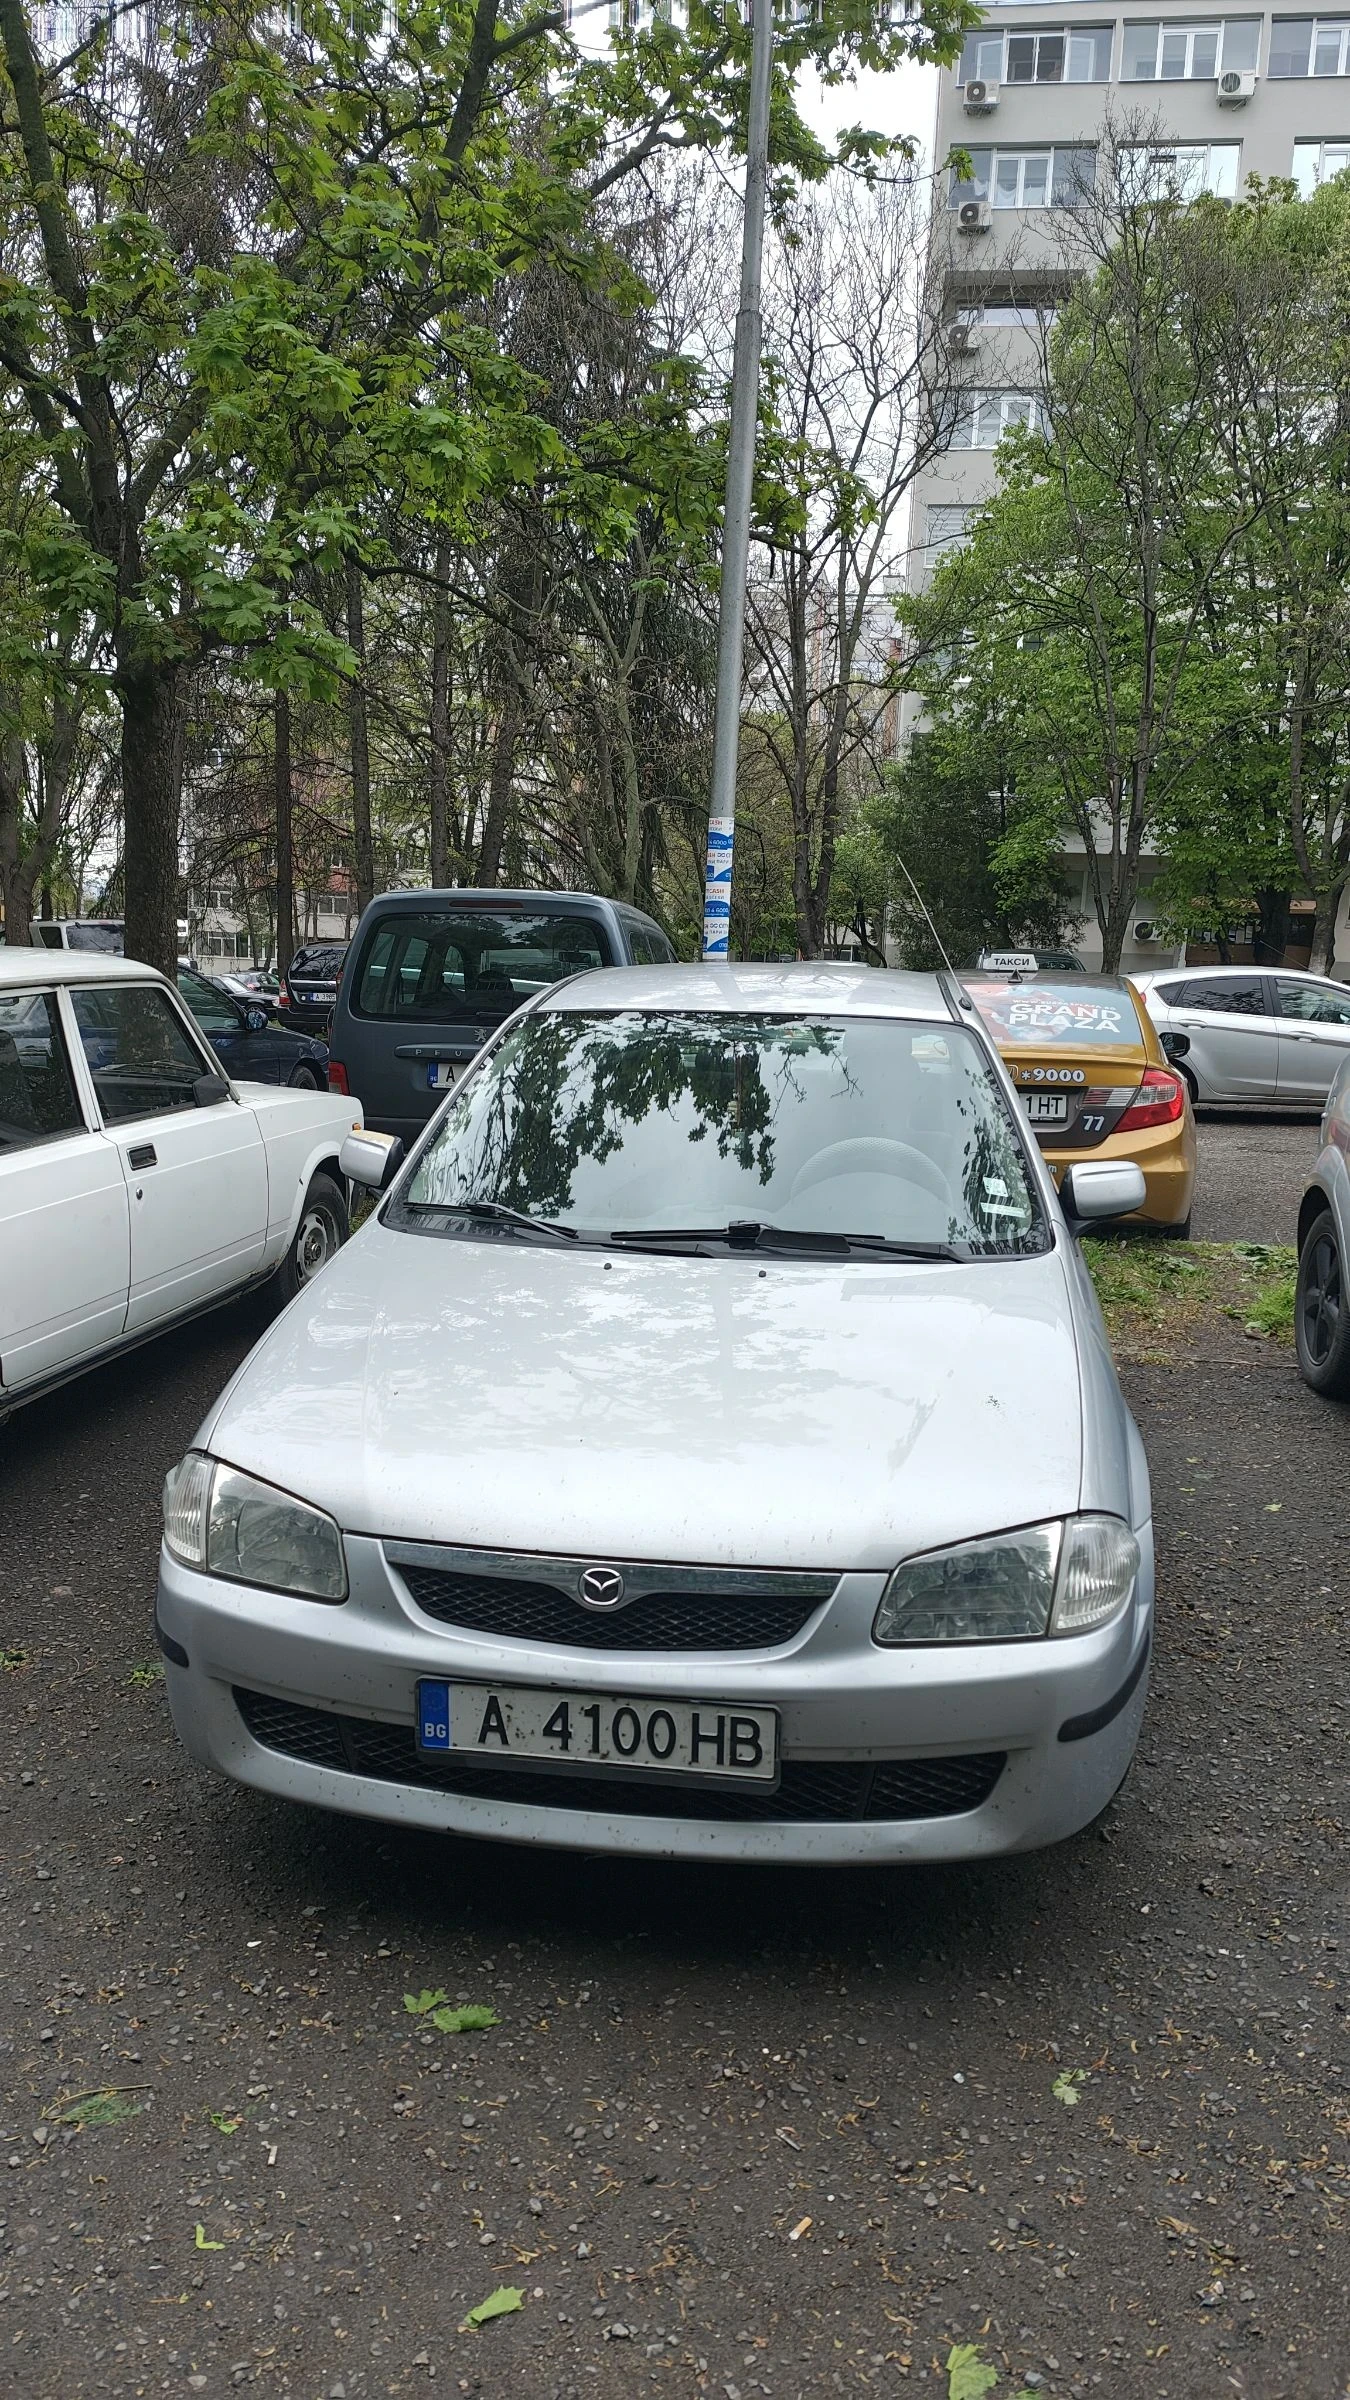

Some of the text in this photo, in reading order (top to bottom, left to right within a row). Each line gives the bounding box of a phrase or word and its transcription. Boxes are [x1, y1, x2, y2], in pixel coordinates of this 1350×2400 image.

[993, 957, 1030, 966] ТАКСИ
[1010, 1003, 1122, 1021] GRAND
[1009, 1013, 1121, 1033] PLAZA
[1082, 1115, 1106, 1132] 77
[424, 1722, 447, 1739] BG
[477, 1695, 763, 1768] A 4100 HB
